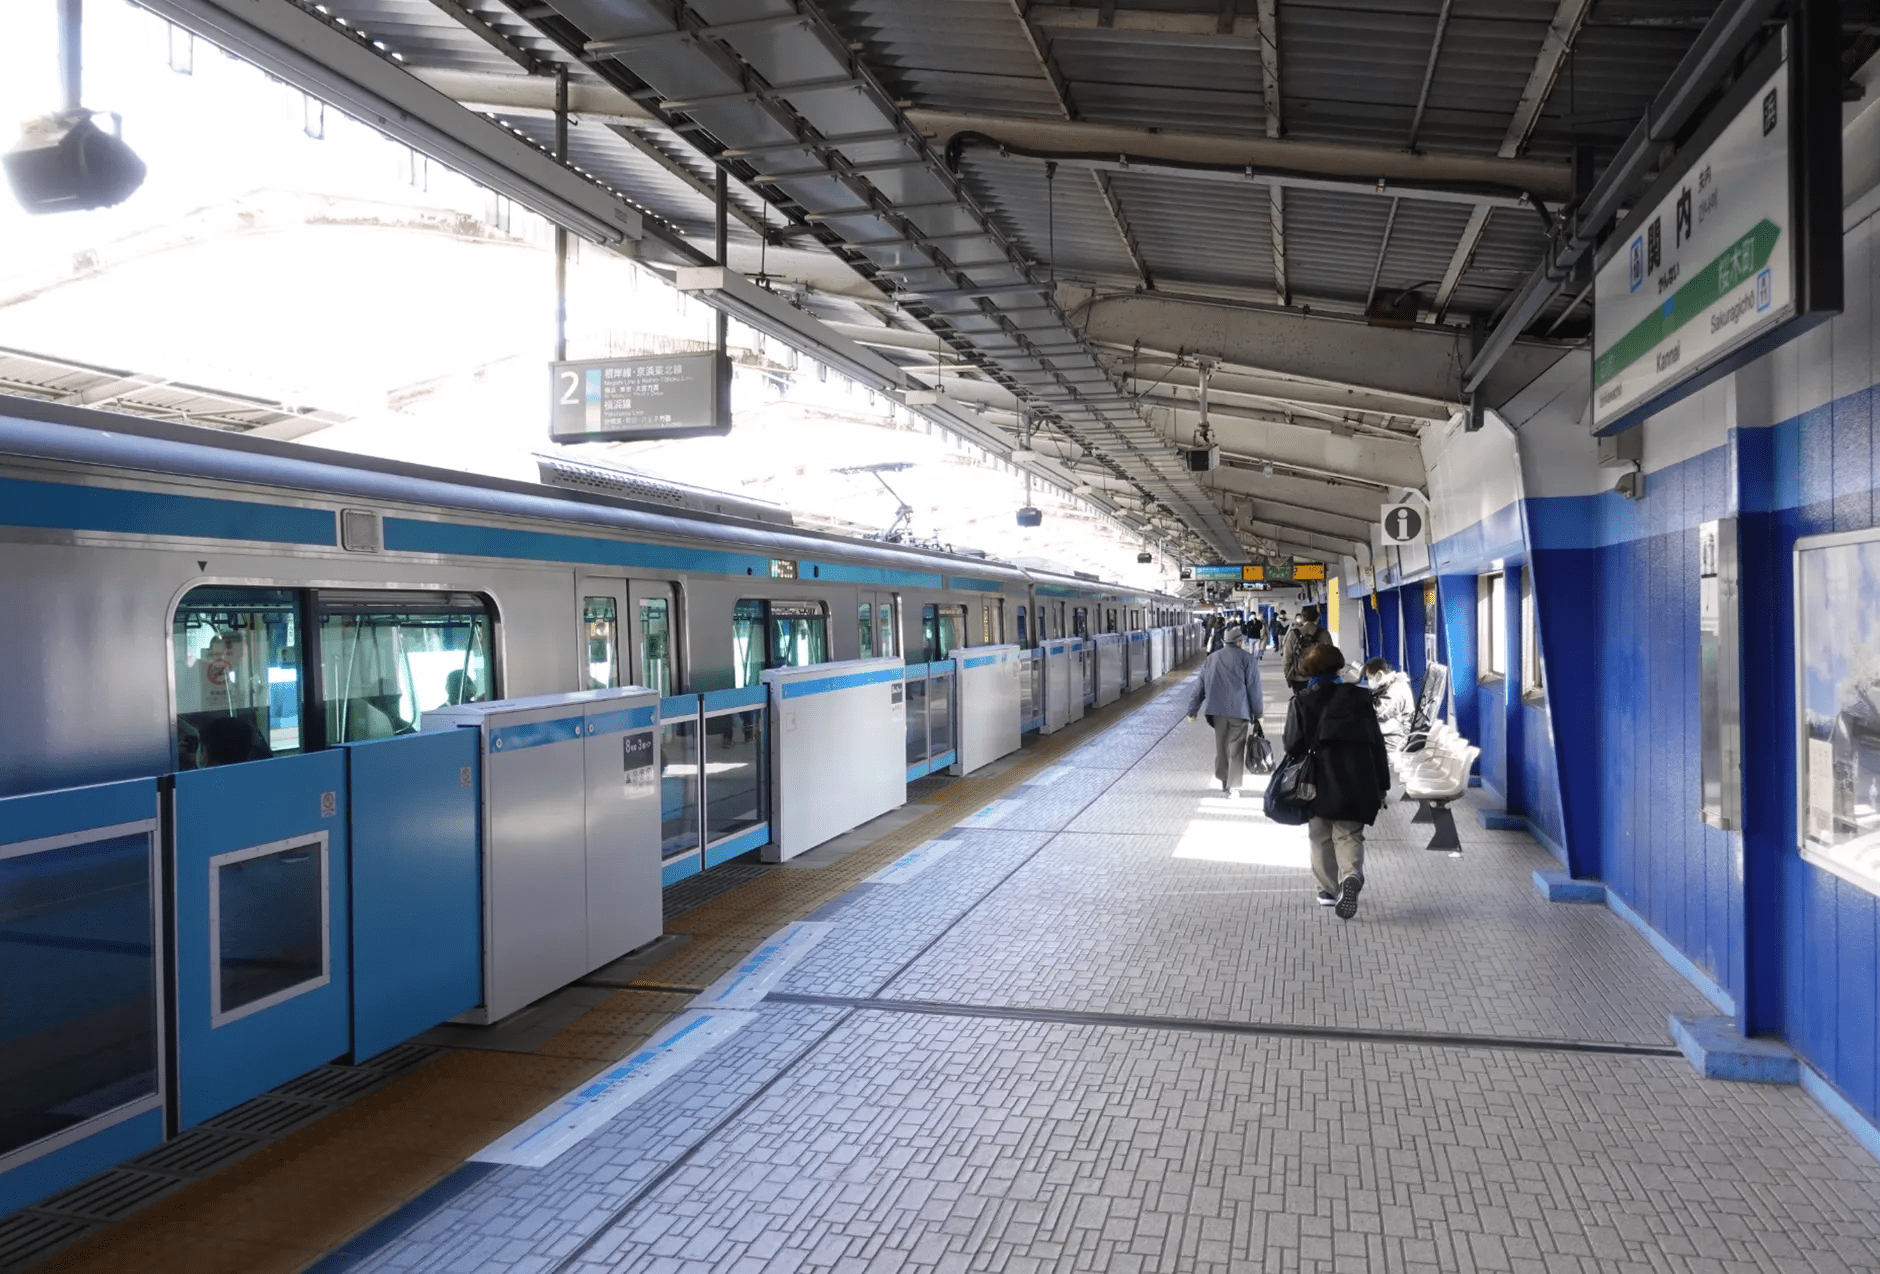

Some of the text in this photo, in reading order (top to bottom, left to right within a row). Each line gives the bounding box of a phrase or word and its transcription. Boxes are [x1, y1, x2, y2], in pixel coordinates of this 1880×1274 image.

[1719, 237, 1755, 294] 桜木町
[1656, 345, 1680, 374] Kannai
[561, 371, 579, 404] 2
